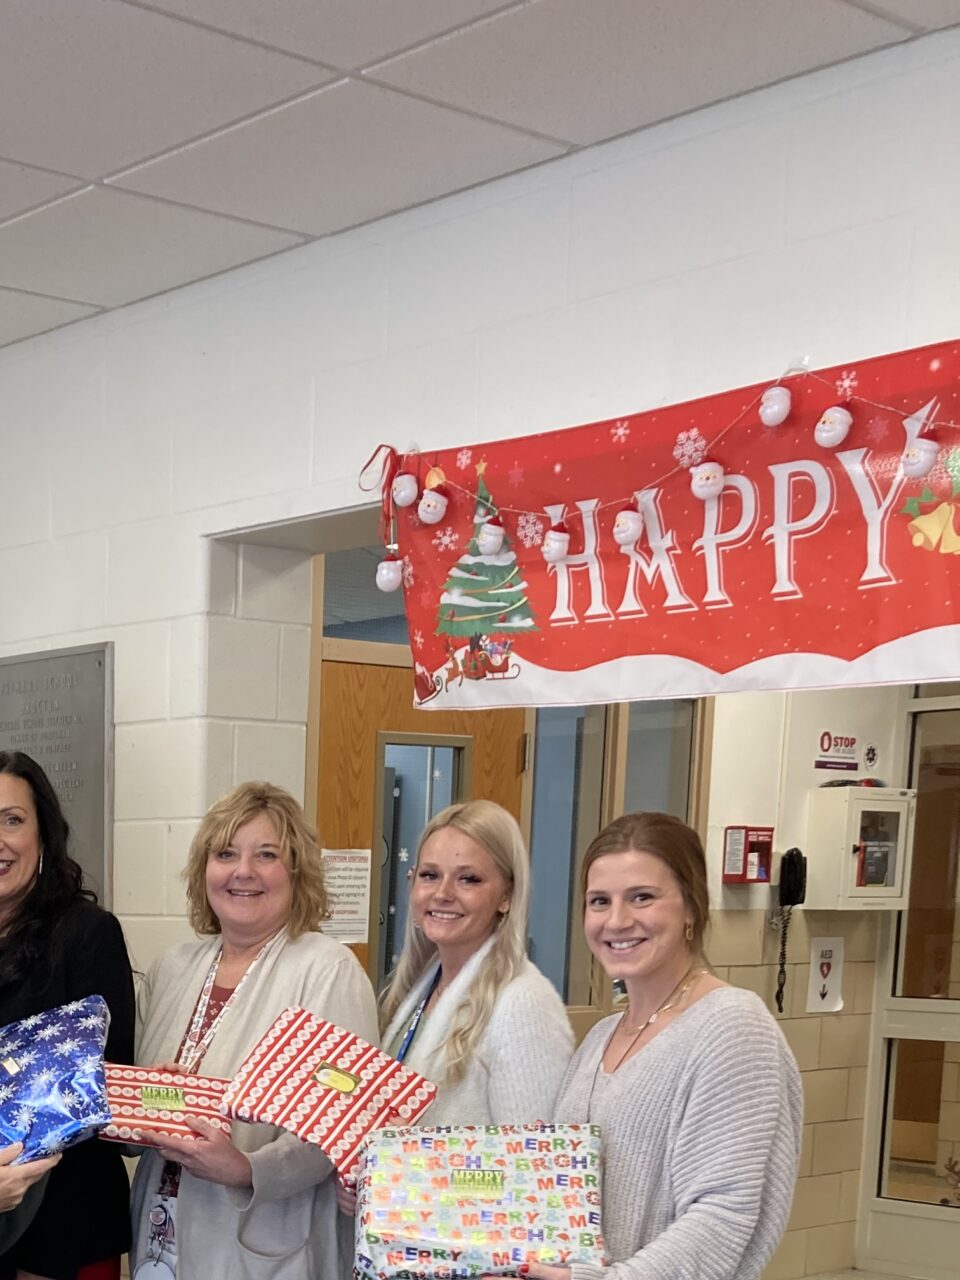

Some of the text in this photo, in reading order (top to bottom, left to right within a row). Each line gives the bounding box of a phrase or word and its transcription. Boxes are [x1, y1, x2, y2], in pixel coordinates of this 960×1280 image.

[543, 396, 941, 627] HAPPY
[833, 736, 856, 748] STOP
[820, 950, 832, 959] AED
[141, 1086, 184, 1099] MERRY
[402, 1137, 477, 1153] MERRY
[506, 1138, 582, 1154] MERRY
[453, 1170, 503, 1185] MERRY
[537, 1174, 597, 1190] MERR
[461, 1210, 540, 1227] MERRY
[386, 1247, 463, 1266] MERRY
